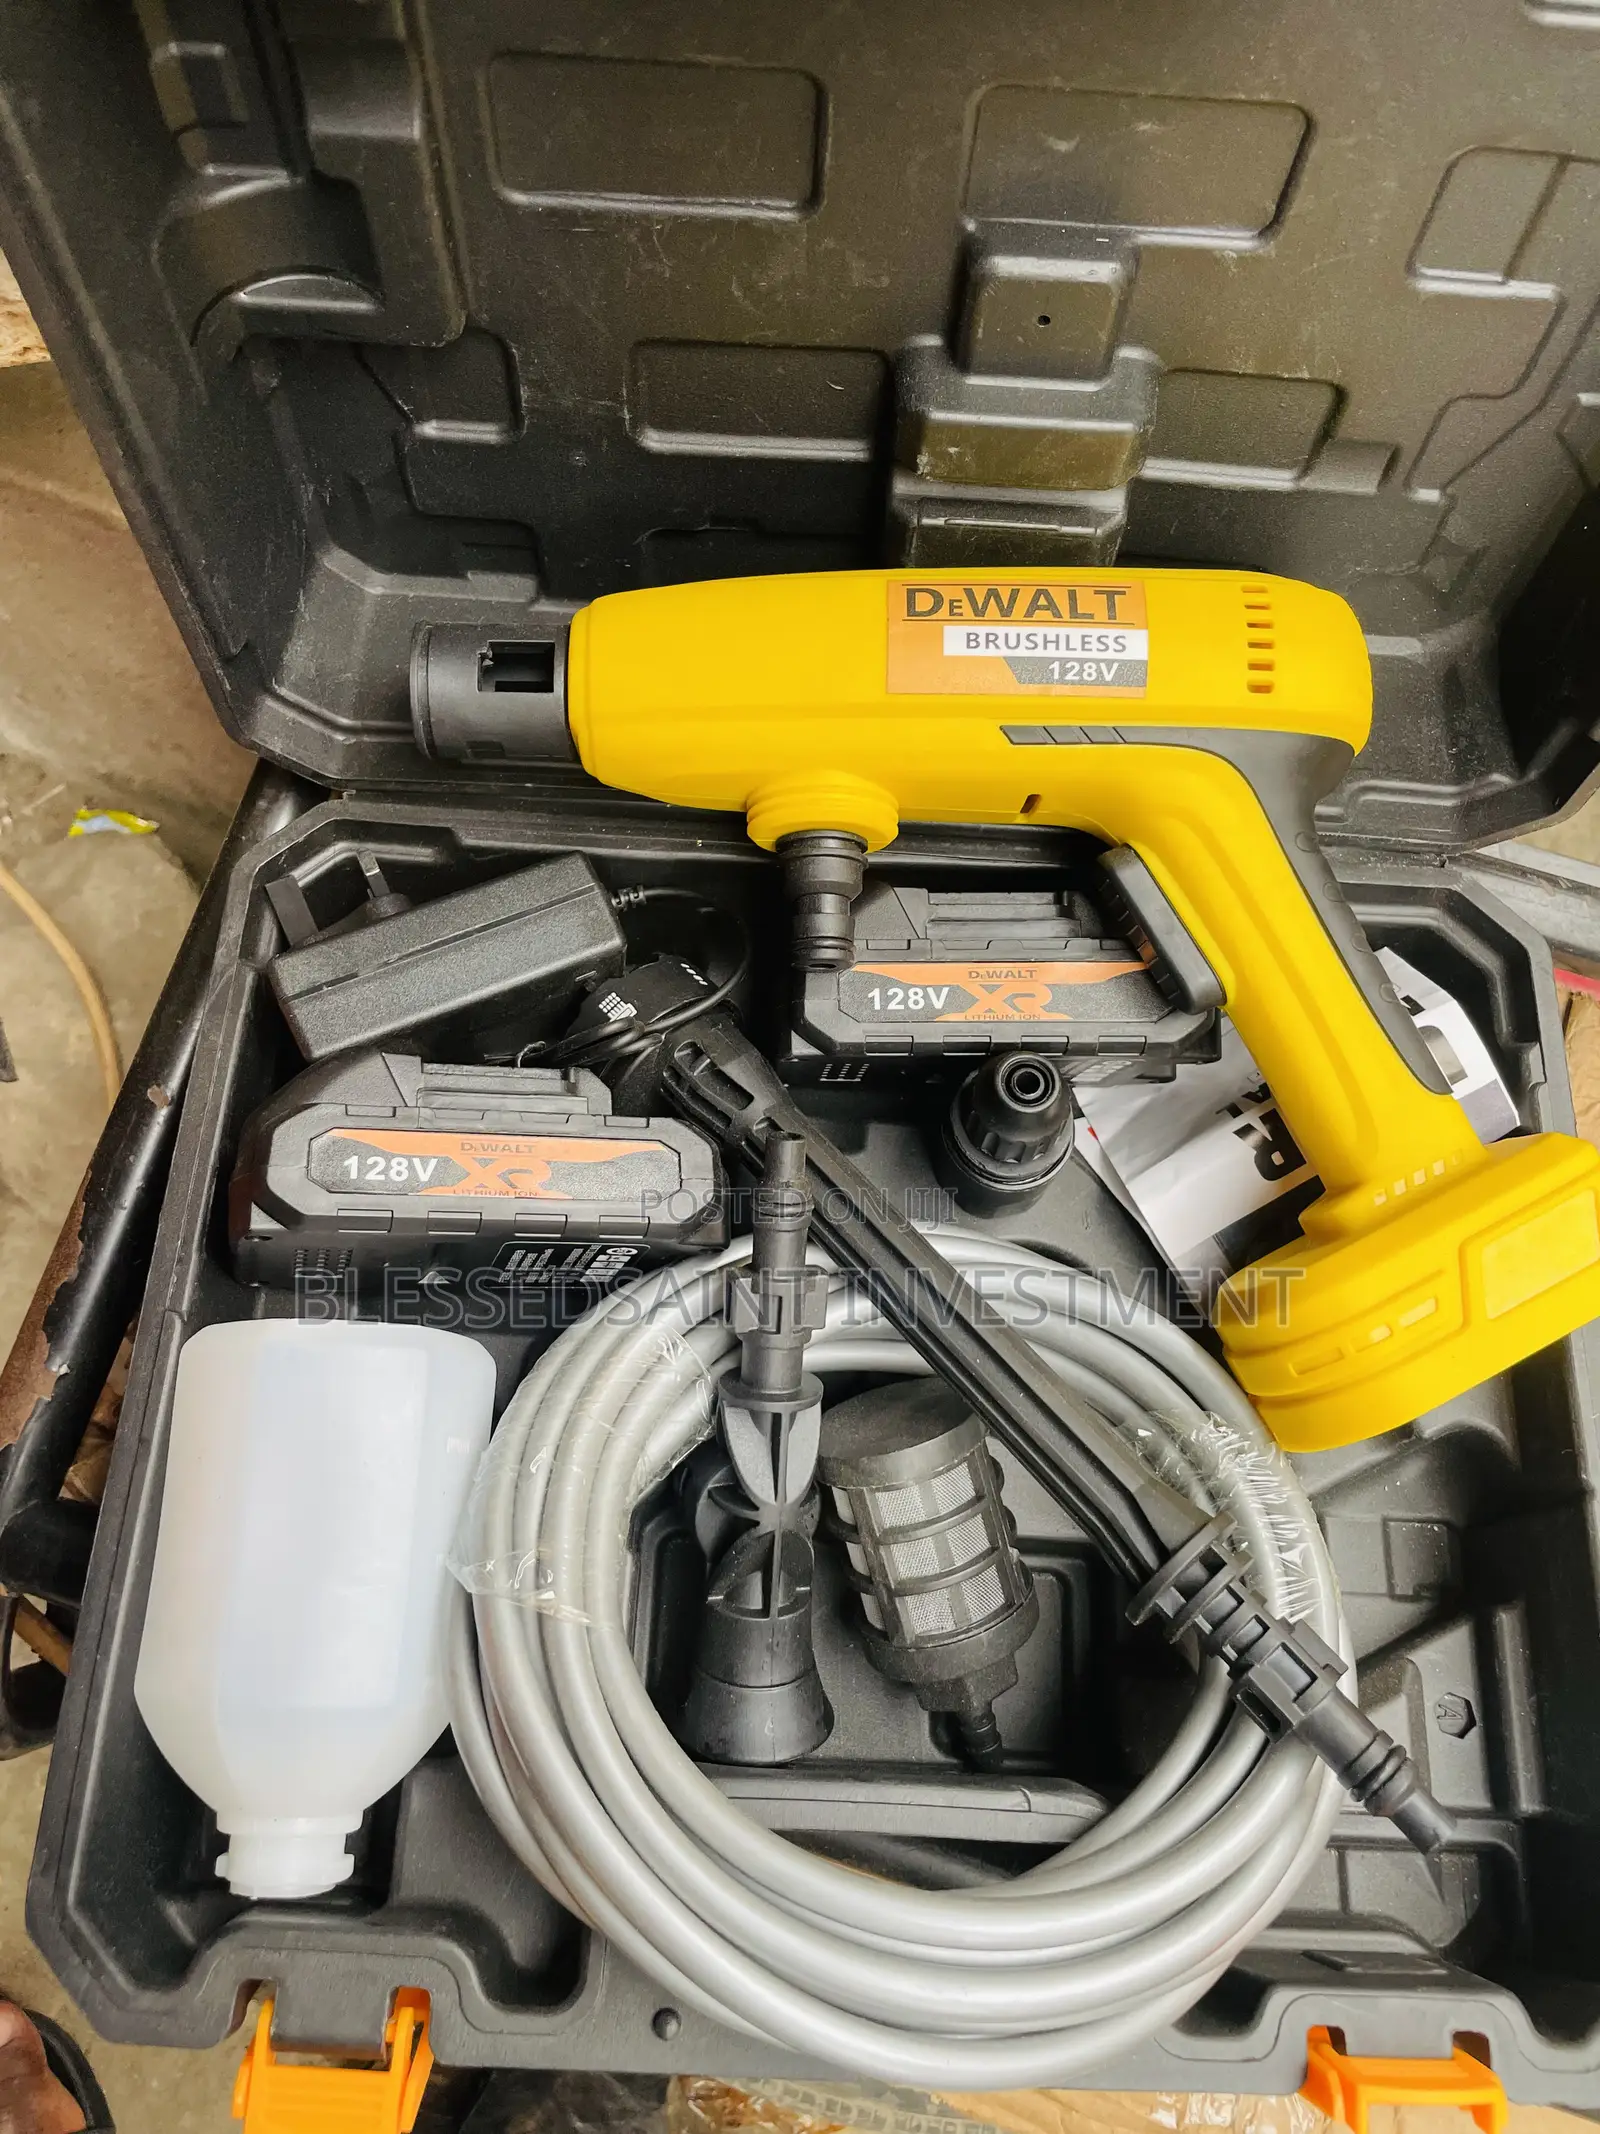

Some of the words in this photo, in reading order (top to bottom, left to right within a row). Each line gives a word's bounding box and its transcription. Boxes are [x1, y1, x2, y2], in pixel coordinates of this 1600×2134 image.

[965, 632, 1127, 653] BRUSHLESS
[1048, 660, 1119, 682] 128V
[866, 986, 950, 1011] 128V
[962, 984, 1053, 1013] XR
[964, 1013, 1015, 1021] LITHIUM
[1018, 1013, 1041, 1021] ION
[343, 1155, 439, 1183] 128V
[452, 1157, 551, 1189] XR
[453, 1188, 509, 1197] LITHIUM
